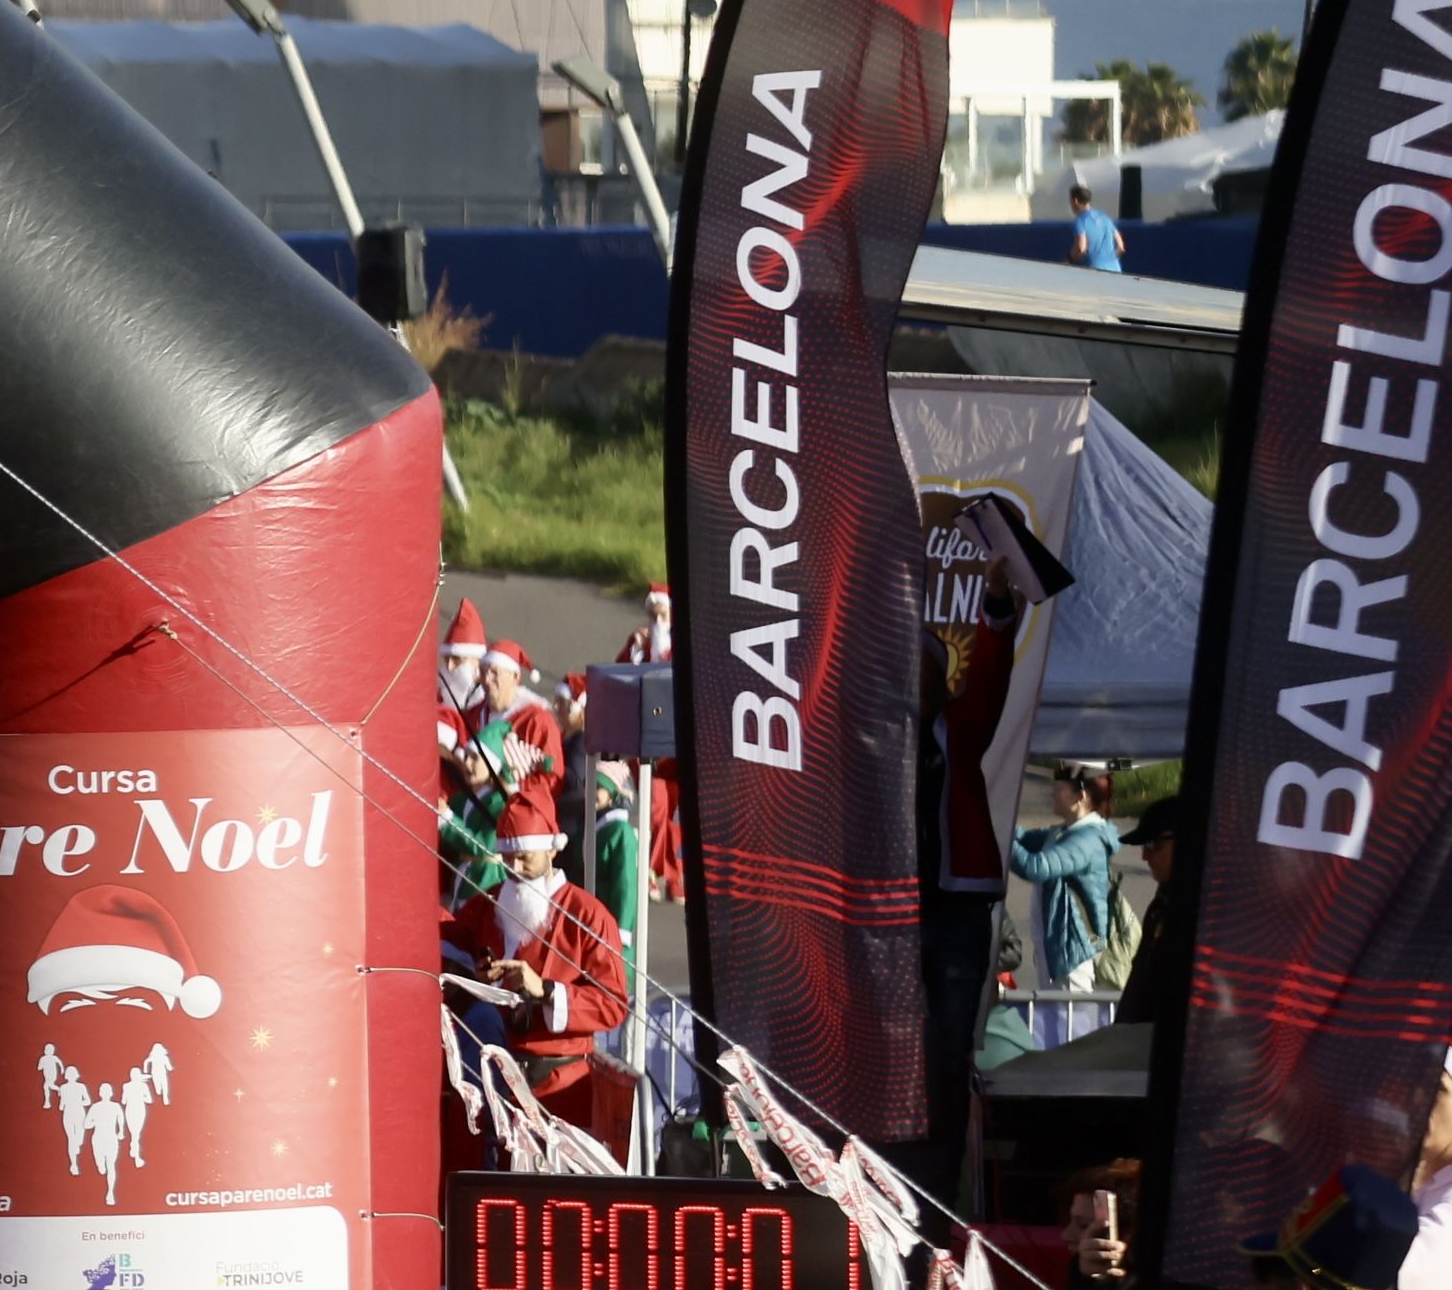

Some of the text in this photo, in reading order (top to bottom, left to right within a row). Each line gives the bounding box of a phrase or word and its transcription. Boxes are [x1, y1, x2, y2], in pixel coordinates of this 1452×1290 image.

[728, 69, 822, 772] BARCELONA
[48, 764, 158, 795] Cursa
[119, 790, 334, 875] Noel
[165, 1182, 333, 1207] cursaparenoel.cat
[82, 1231, 145, 1241] En benefici
[222, 1271, 303, 1286] TRINIJOVE
